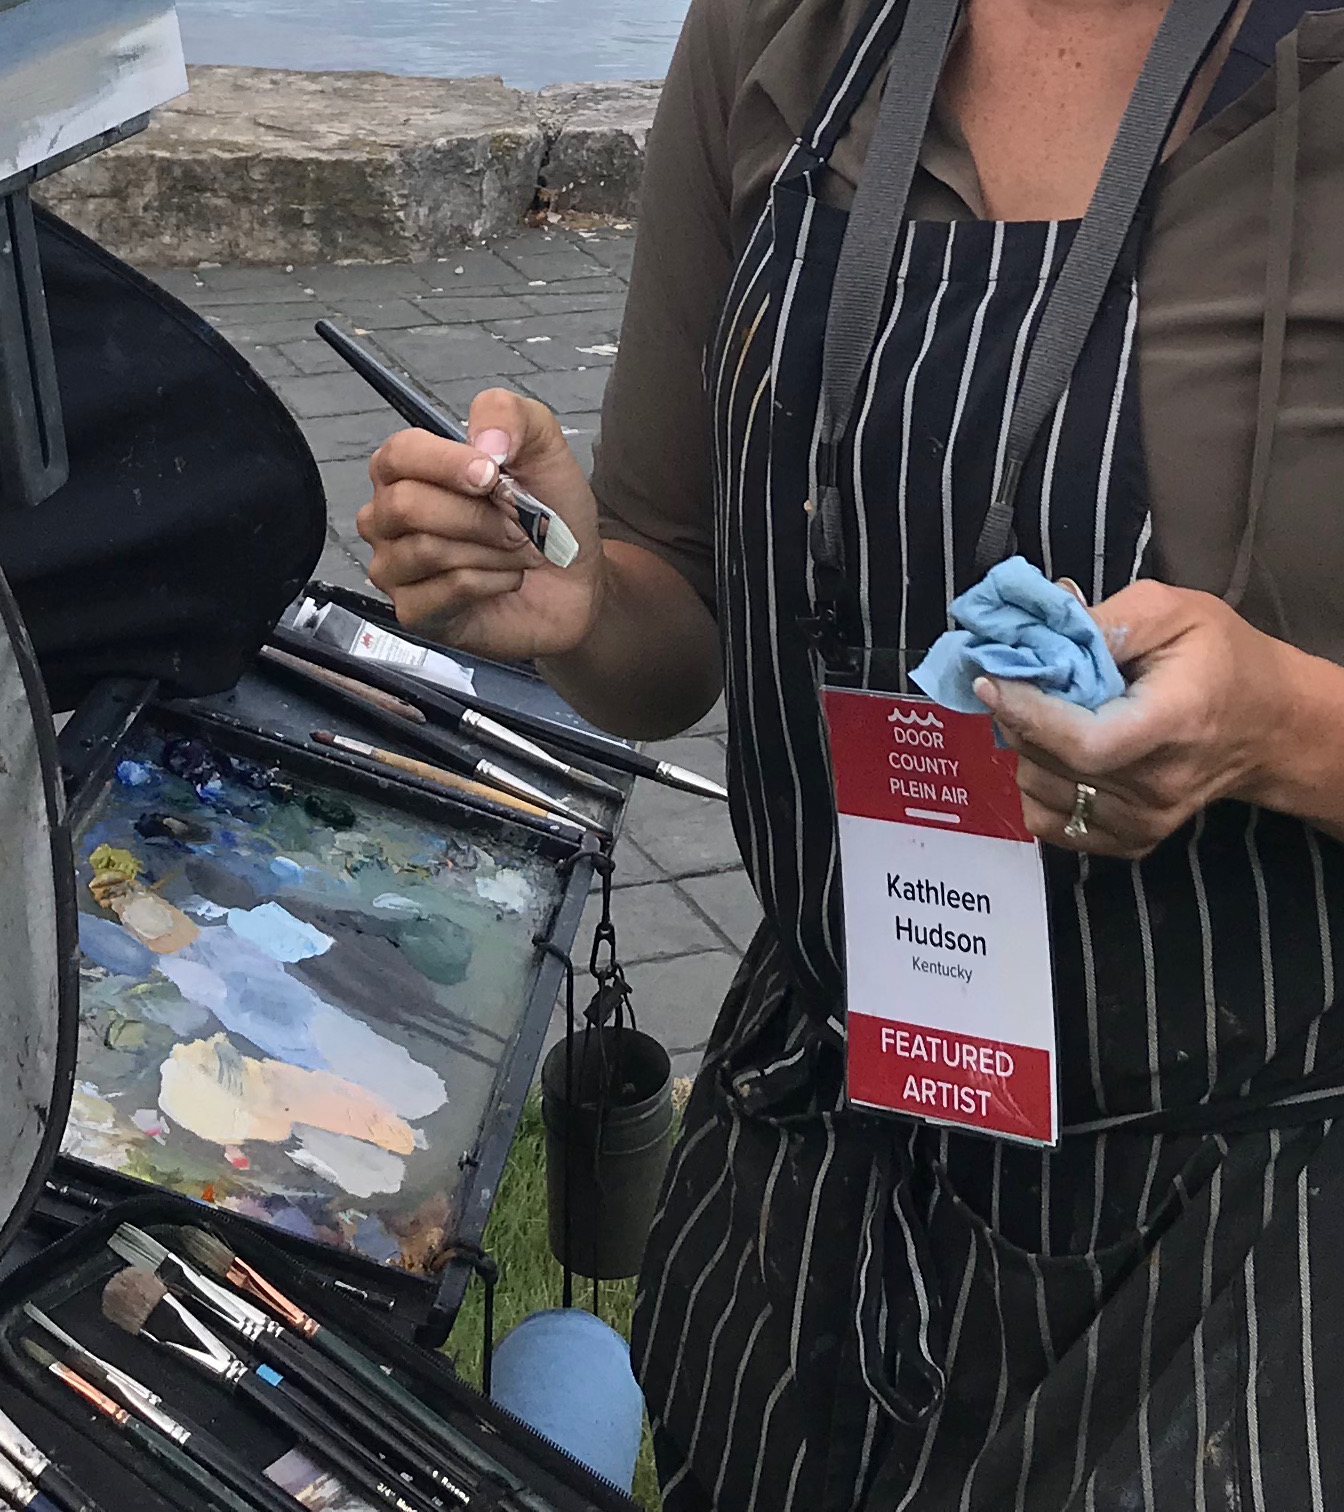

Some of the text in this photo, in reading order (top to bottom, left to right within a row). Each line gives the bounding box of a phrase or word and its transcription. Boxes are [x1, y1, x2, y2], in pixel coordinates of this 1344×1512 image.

[893, 726, 945, 749] DOOR
[888, 751, 959, 777] COUNTY
[889, 777, 969, 806] PLEIN AIR
[886, 872, 991, 914] Kathleen
[895, 915, 987, 956] Hudson
[912, 955, 973, 984] Kentucky
[881, 1027, 1015, 1077] FEATURED
[902, 1074, 992, 1117] ARTIST
